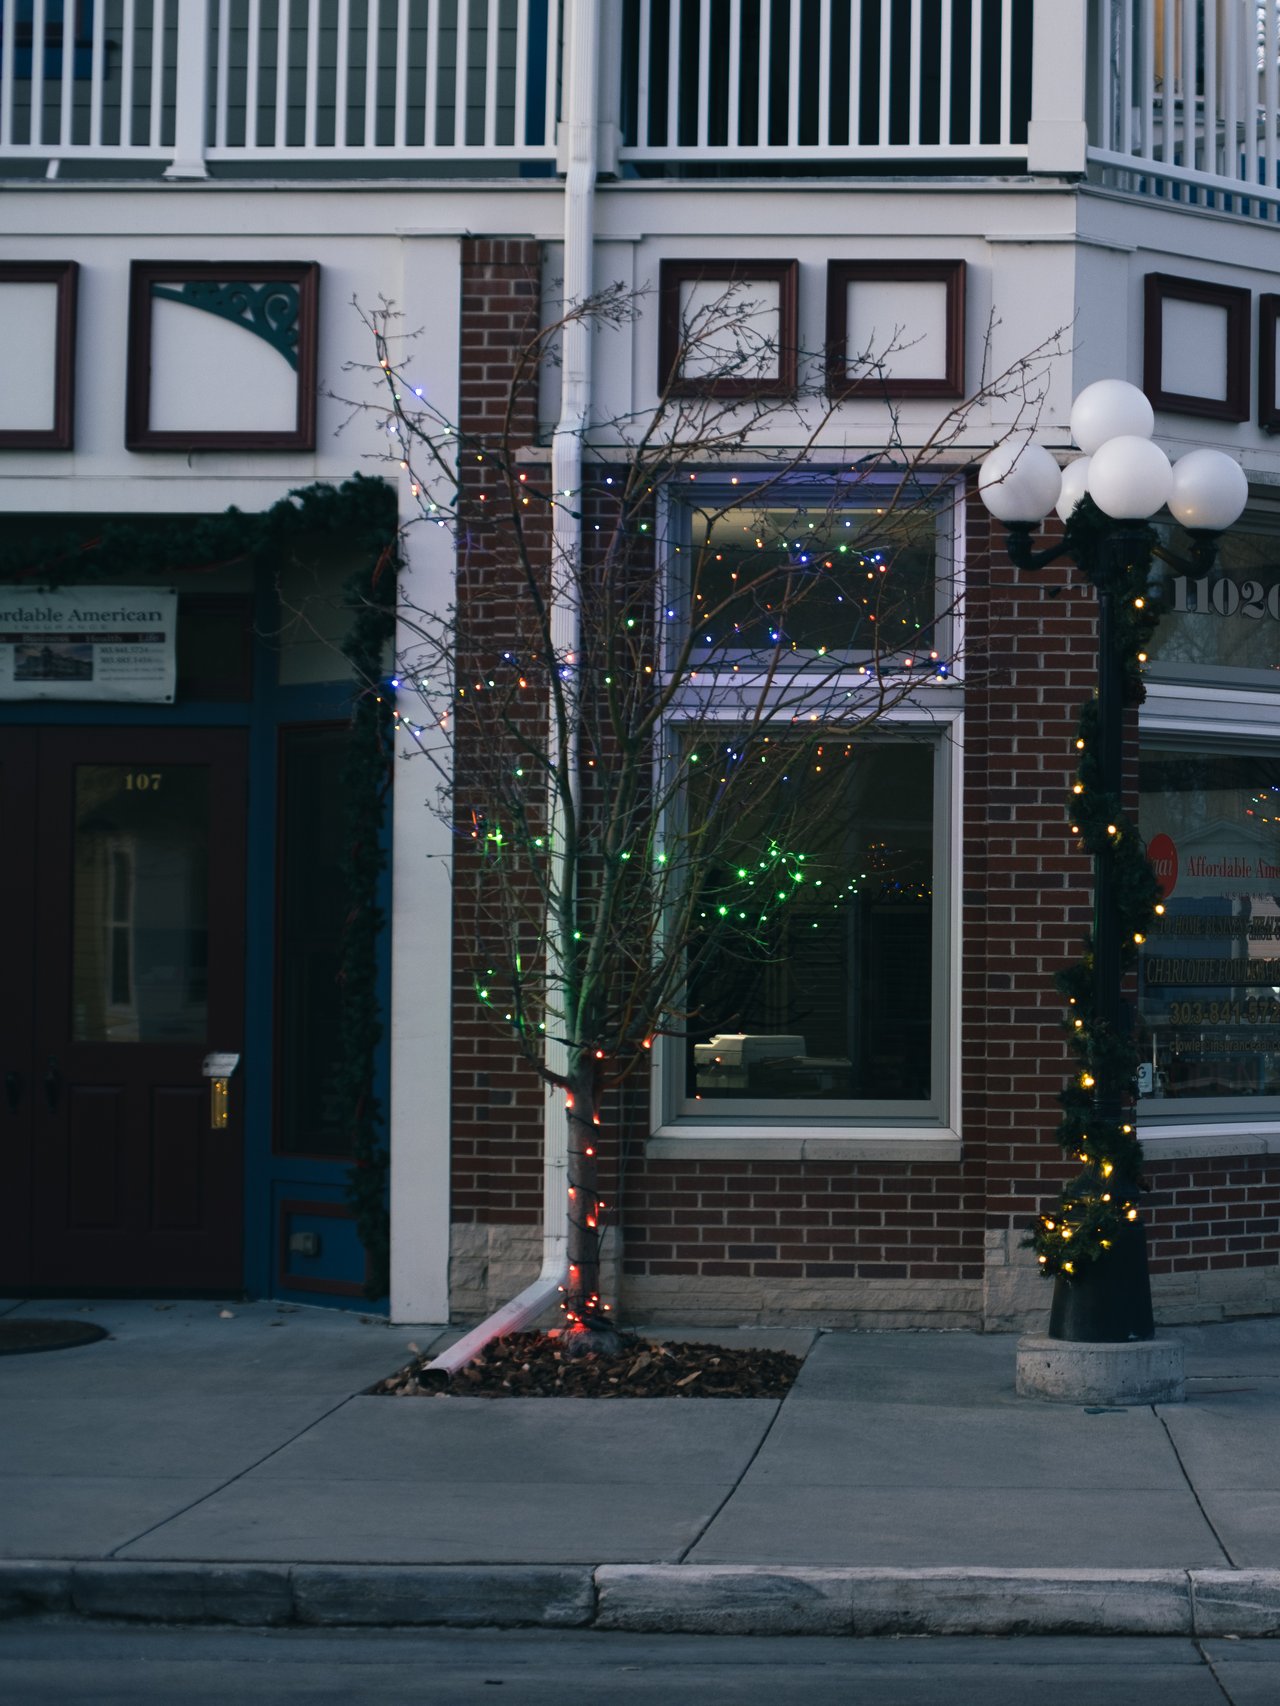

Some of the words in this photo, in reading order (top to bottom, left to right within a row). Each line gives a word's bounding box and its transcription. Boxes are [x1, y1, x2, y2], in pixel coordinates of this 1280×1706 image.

[0, 607, 62, 622] rdable
[68, 607, 162, 622] American
[85, 633, 123, 643] Health
[138, 633, 161, 642] Life
[124, 773, 162, 790] 107
[1186, 855, 1252, 879] Affordable
[1147, 958, 1217, 983] CHARLOTTE
